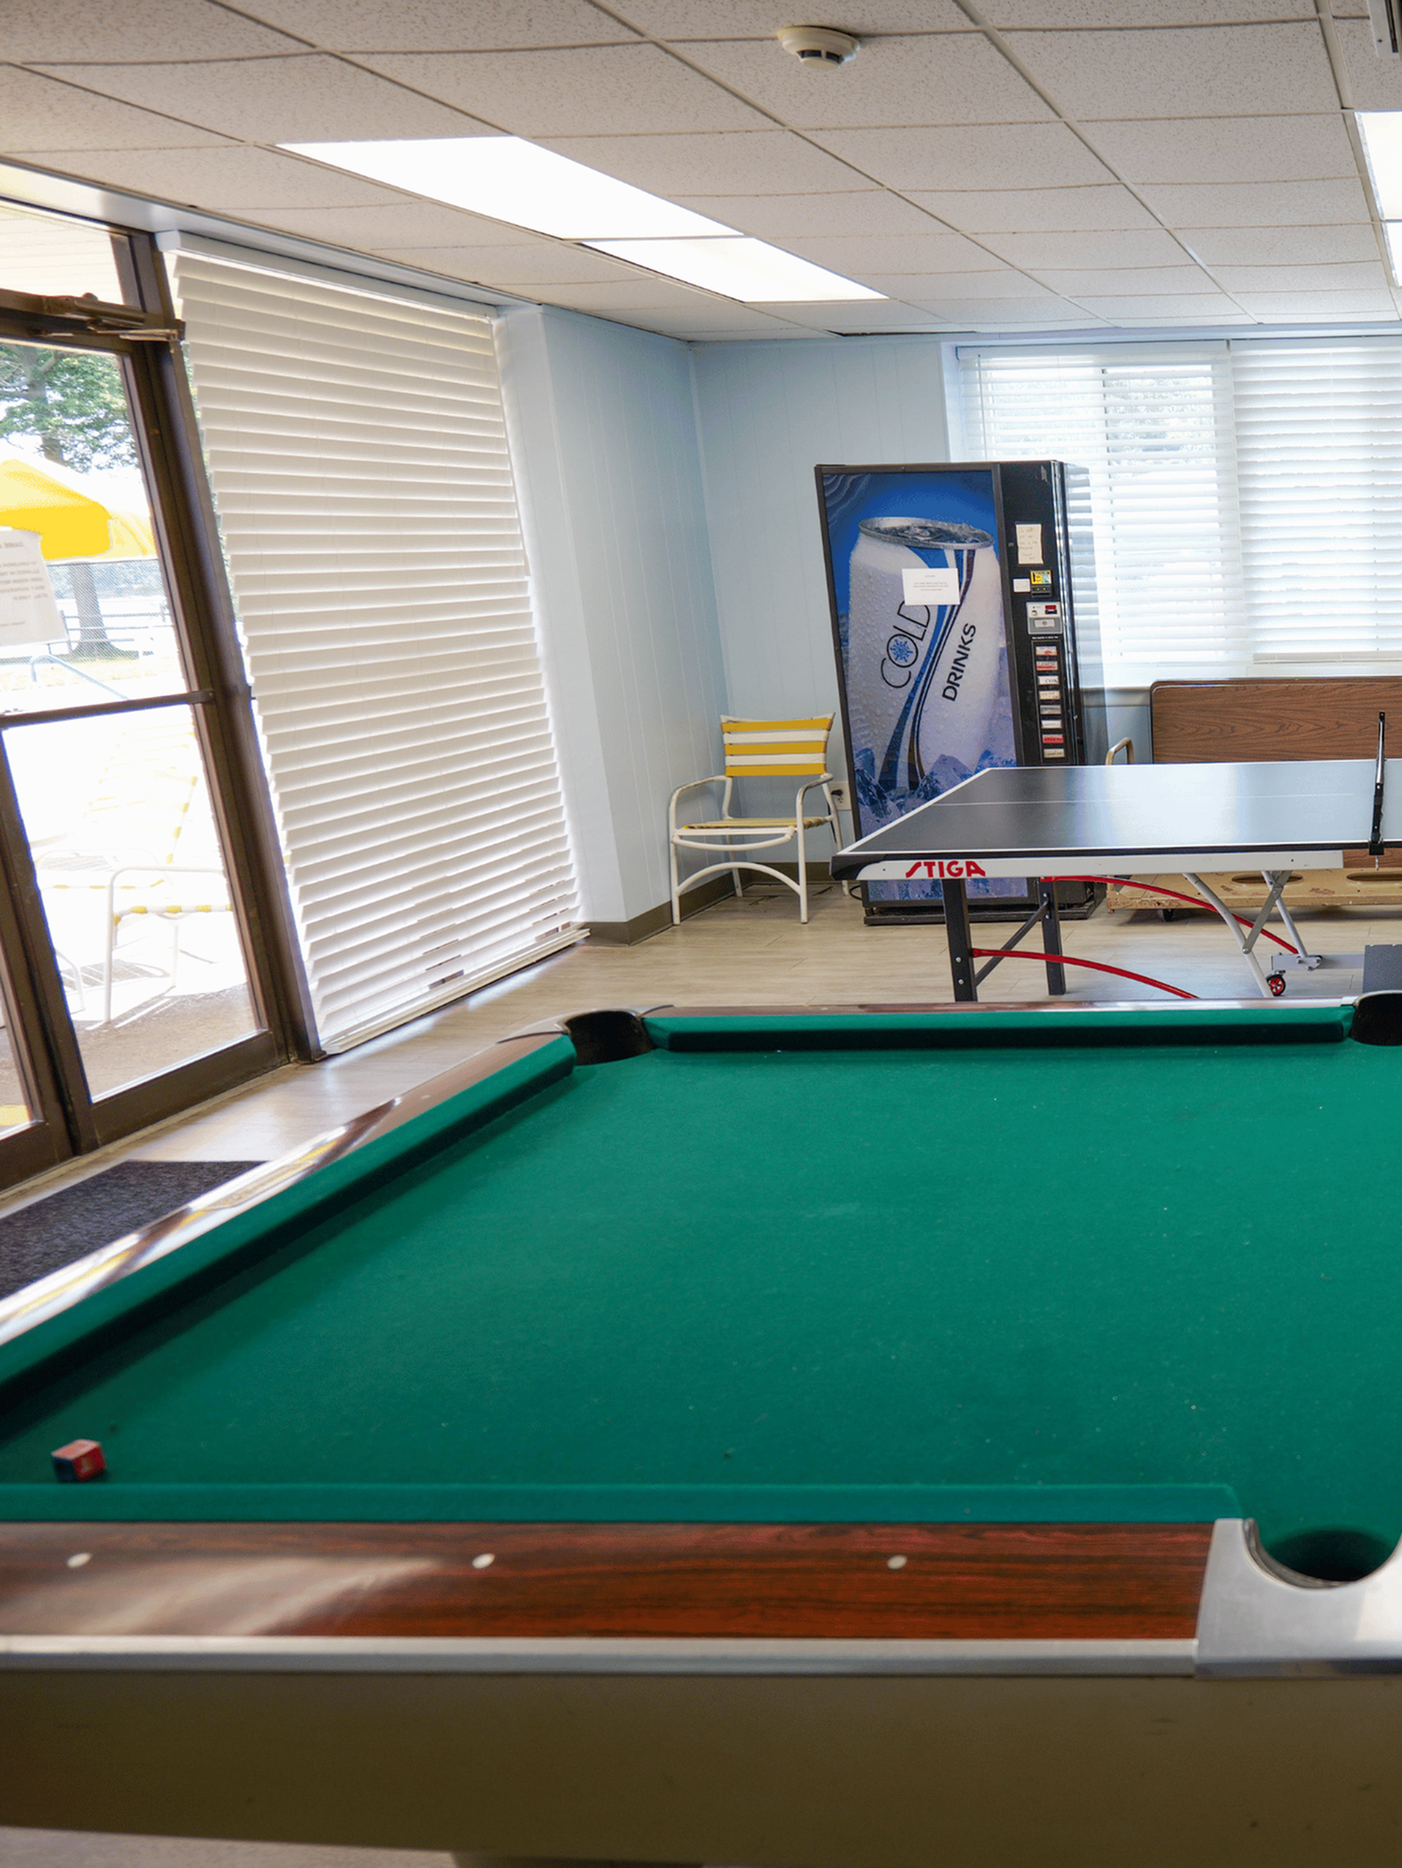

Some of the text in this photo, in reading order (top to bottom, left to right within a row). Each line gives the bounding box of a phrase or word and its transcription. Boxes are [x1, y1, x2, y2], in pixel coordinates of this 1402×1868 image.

[881, 600, 931, 689] COLD
[941, 622, 976, 702] DRINKS
[905, 860, 986, 878] STIGA
